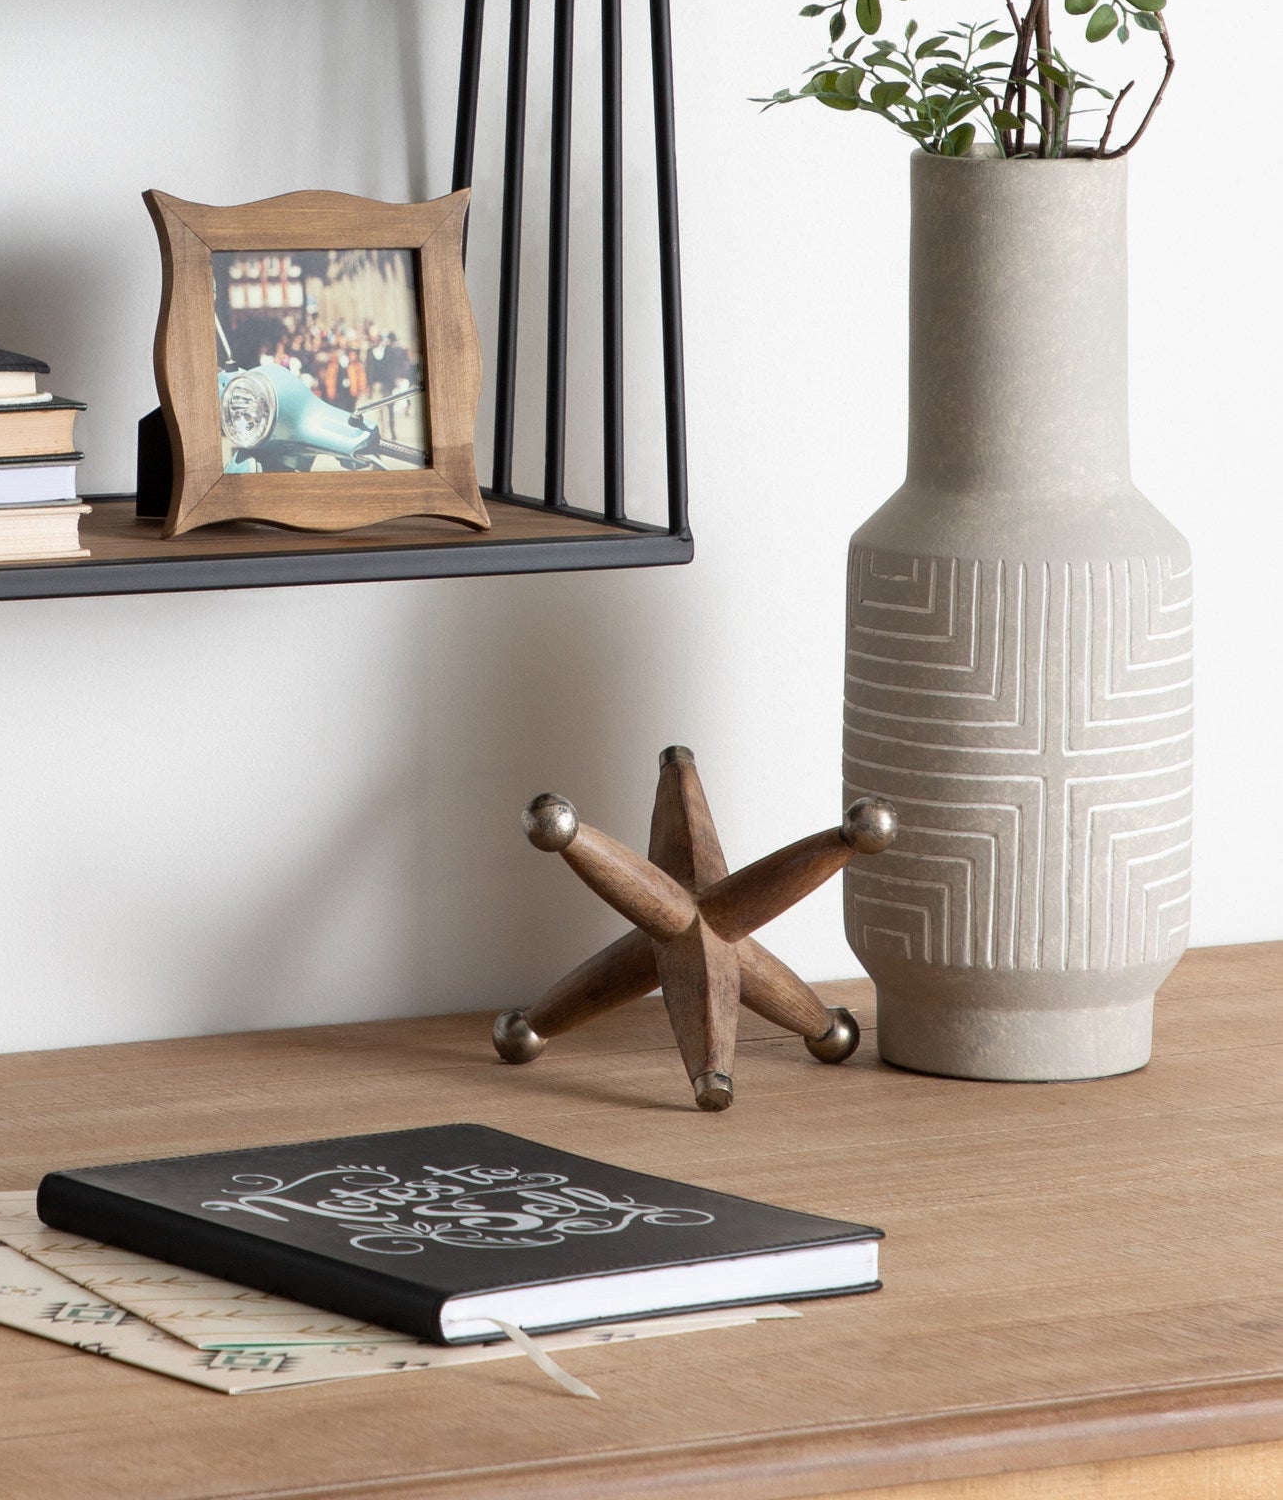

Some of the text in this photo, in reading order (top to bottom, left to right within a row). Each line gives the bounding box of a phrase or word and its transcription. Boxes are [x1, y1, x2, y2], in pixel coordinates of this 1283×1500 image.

[201, 1164, 520, 1223] Notes to
[412, 1187, 677, 1235] Self
